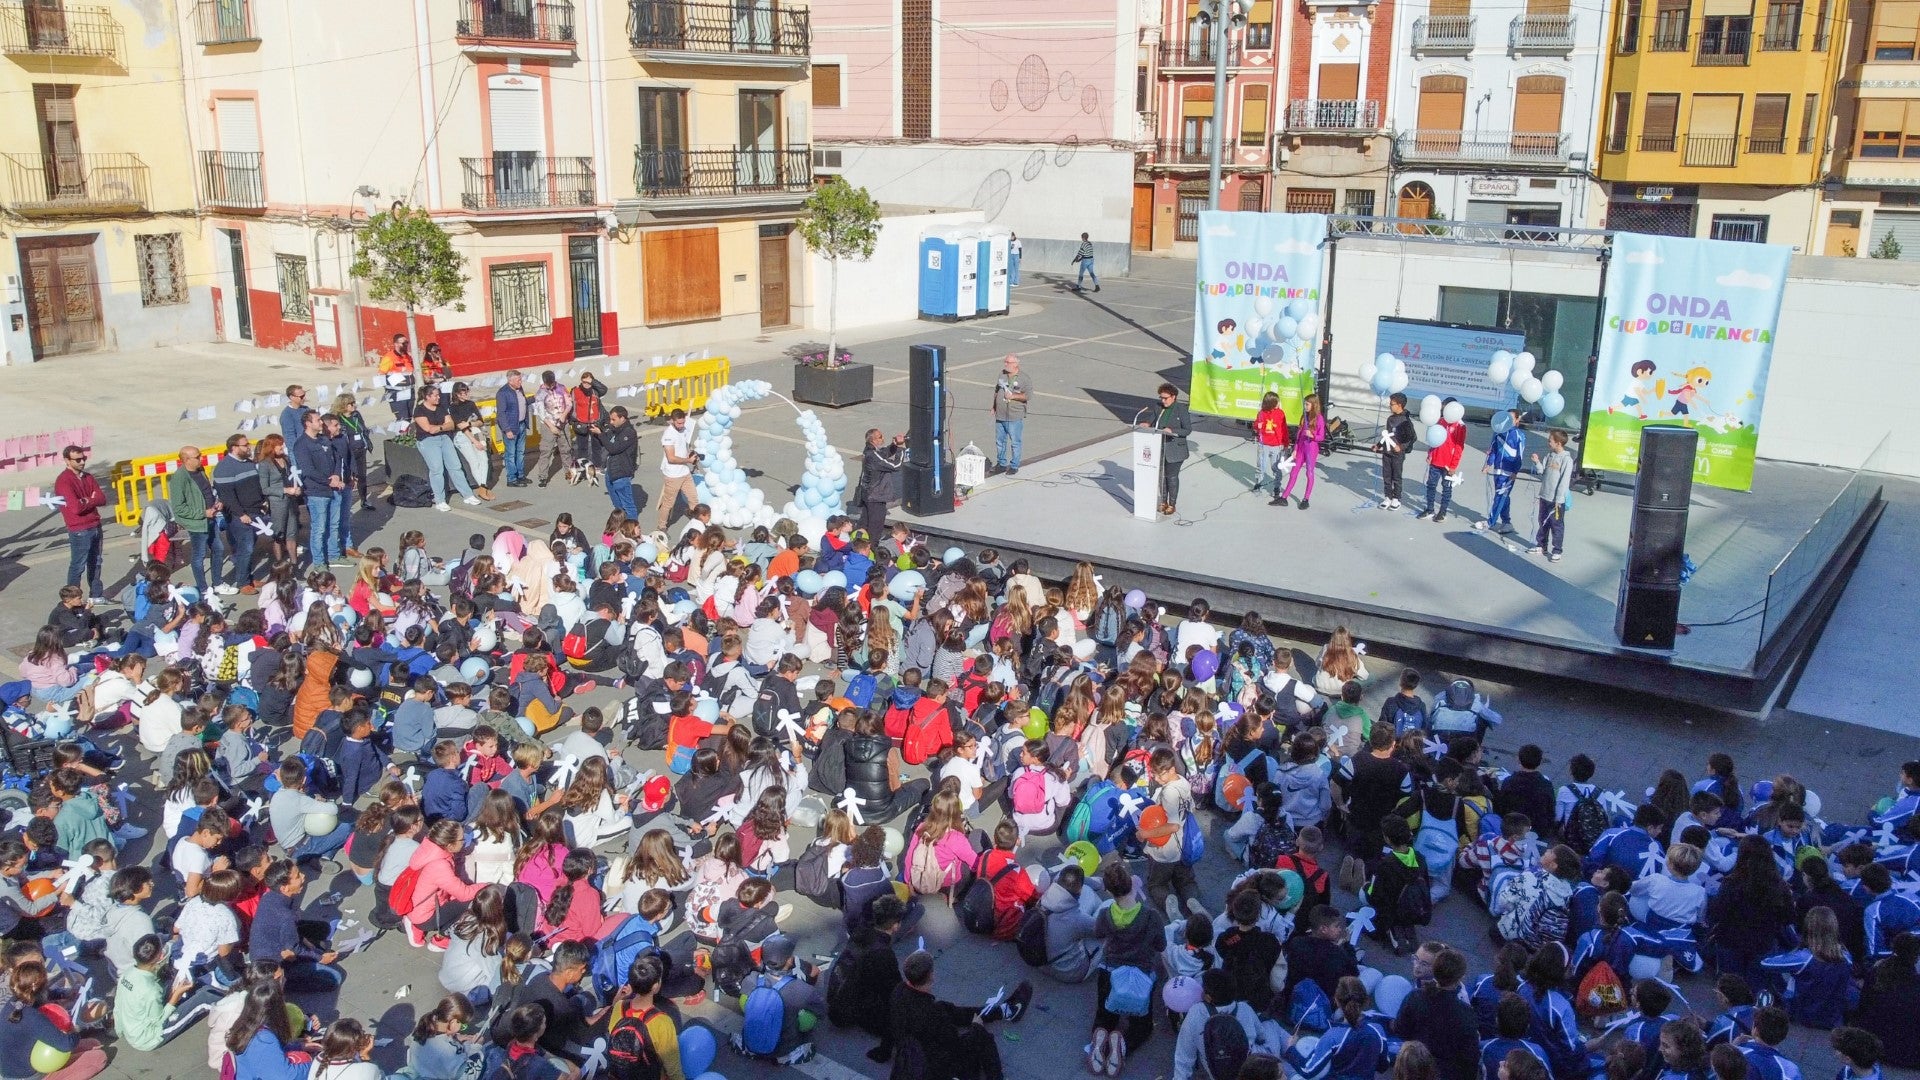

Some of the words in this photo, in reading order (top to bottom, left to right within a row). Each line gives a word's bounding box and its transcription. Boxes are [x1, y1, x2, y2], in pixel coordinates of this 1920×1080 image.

[1479, 182, 1512, 191] ESPAÑOL
[1225, 261, 1288, 282] ONDA
[1199, 281, 1245, 297] CIUDAD
[1255, 285, 1319, 301] INFANCIA
[1646, 292, 1732, 321] ONDA
[1609, 315, 1669, 336] CIUDAD
[1685, 322, 1771, 344] INFANCIA
[1474, 336, 1504, 346] ONDA
[1711, 447, 1733, 456] Onda
